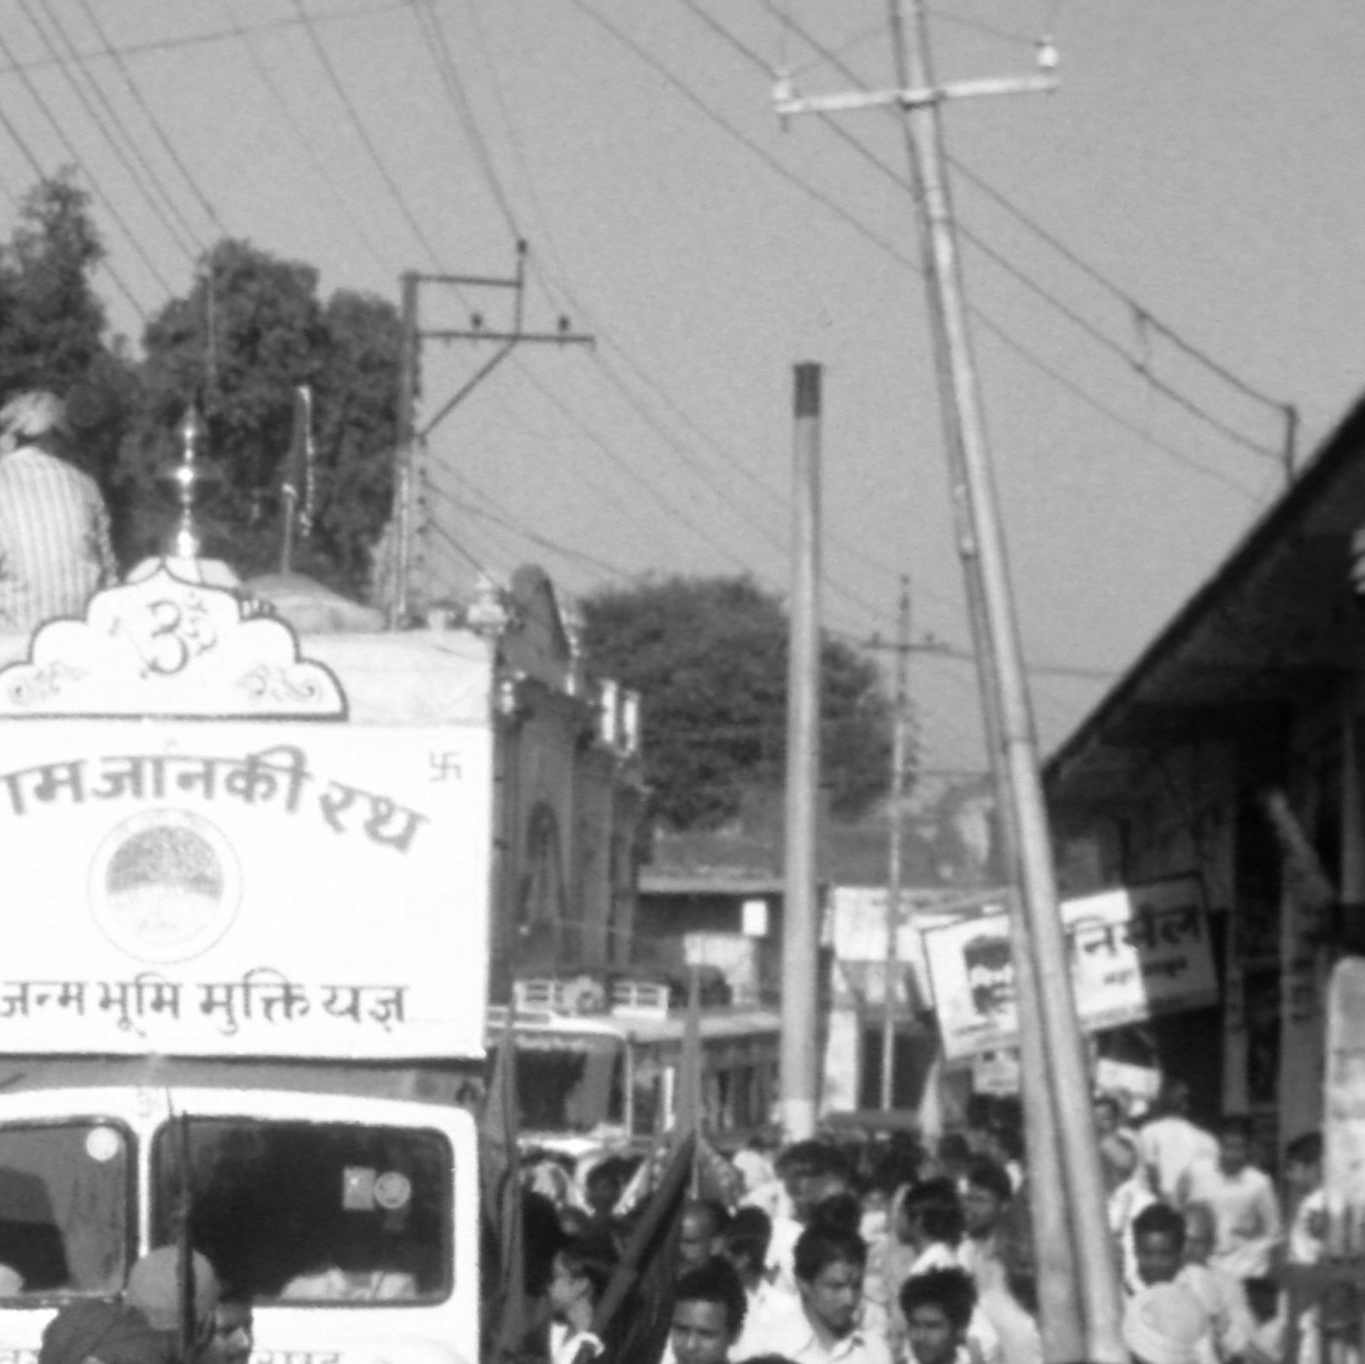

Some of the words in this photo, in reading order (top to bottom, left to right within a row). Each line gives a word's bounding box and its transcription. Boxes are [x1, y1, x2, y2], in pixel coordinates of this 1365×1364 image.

[319, 779, 431, 854] रथ
[197, 966, 311, 1036] मुक्ति
[319, 984, 412, 1033] यज्ञ
